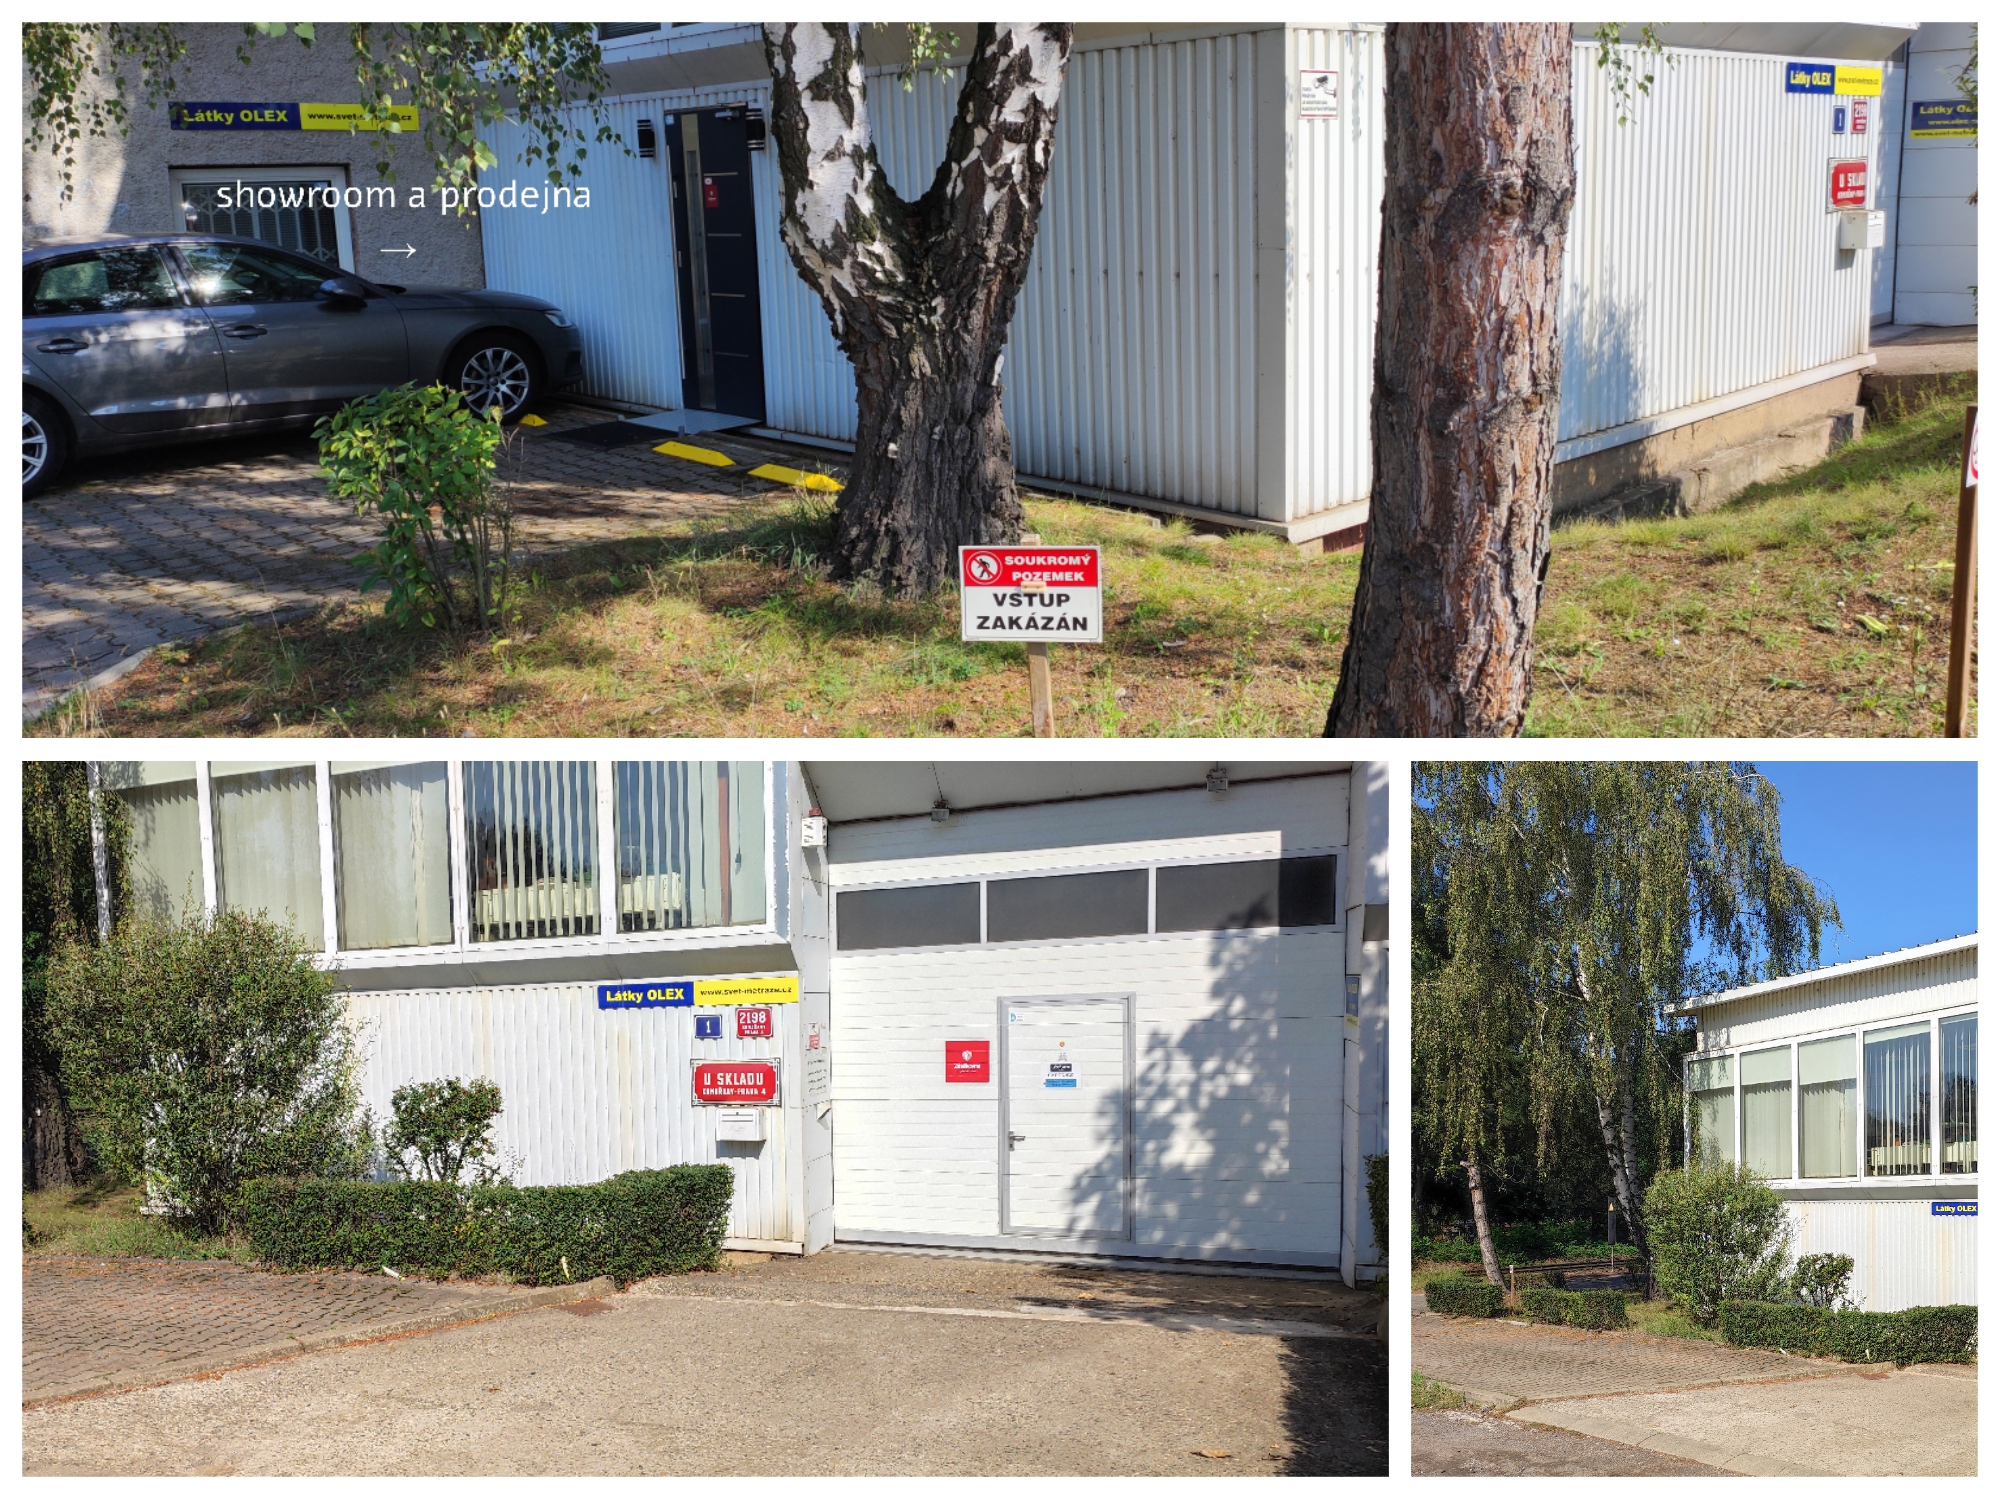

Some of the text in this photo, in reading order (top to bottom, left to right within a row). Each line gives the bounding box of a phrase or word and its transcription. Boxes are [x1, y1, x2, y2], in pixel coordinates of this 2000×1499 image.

[1811, 71, 1831, 86] OLEX
[1920, 104, 1953, 115] Látky
[183, 109, 288, 125] Látky OLEX
[1004, 553, 1092, 566] SOUKROMÝ
[1012, 571, 1085, 582] POZEMEK
[993, 592, 1071, 608] VSTUP
[976, 612, 1088, 632] ZAKÁZÁN
[606, 988, 684, 1004] Látky OLEX
[739, 1011, 767, 1024] 2198
[706, 1020, 711, 1034] 1
[703, 1072, 764, 1086] U SKLADU
[761, 1087, 767, 1095] 4
[1935, 1205, 1955, 1213] Látky
